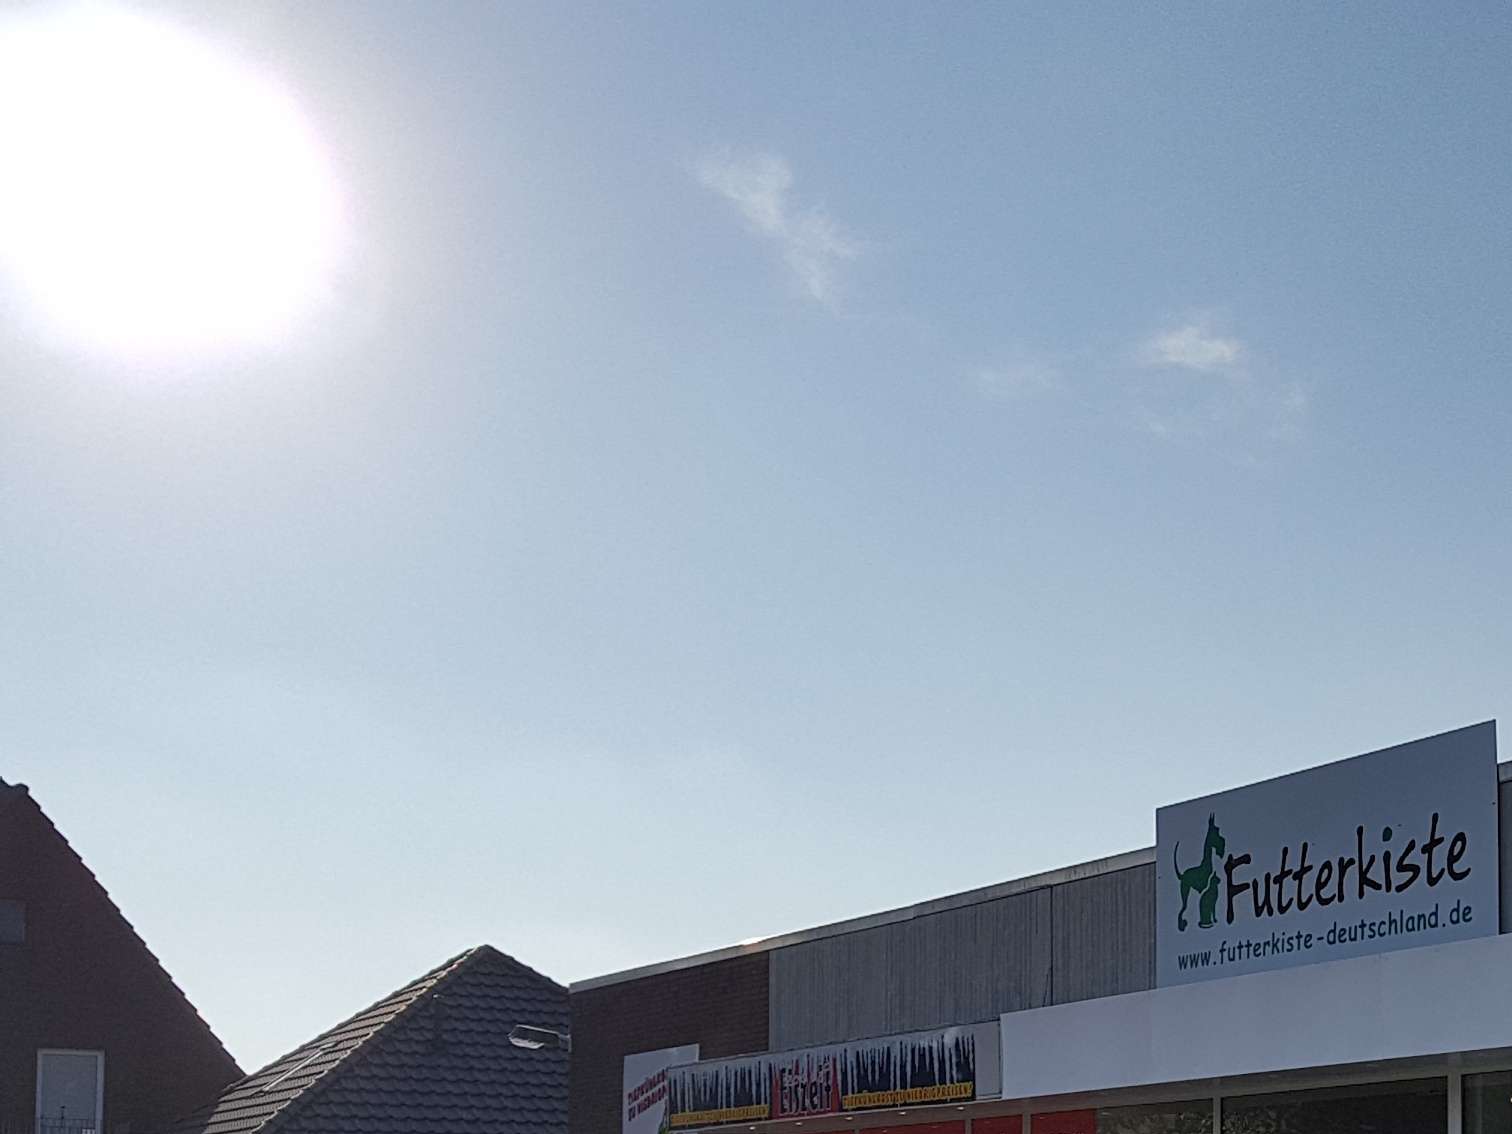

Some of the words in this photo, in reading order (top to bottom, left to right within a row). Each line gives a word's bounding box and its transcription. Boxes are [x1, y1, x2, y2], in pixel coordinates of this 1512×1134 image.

[1224, 812, 1471, 925] Futterkiste
[1178, 899, 1473, 972] www.futterkiste-deutschland.de
[780, 1058, 832, 1116] Eiszeit
